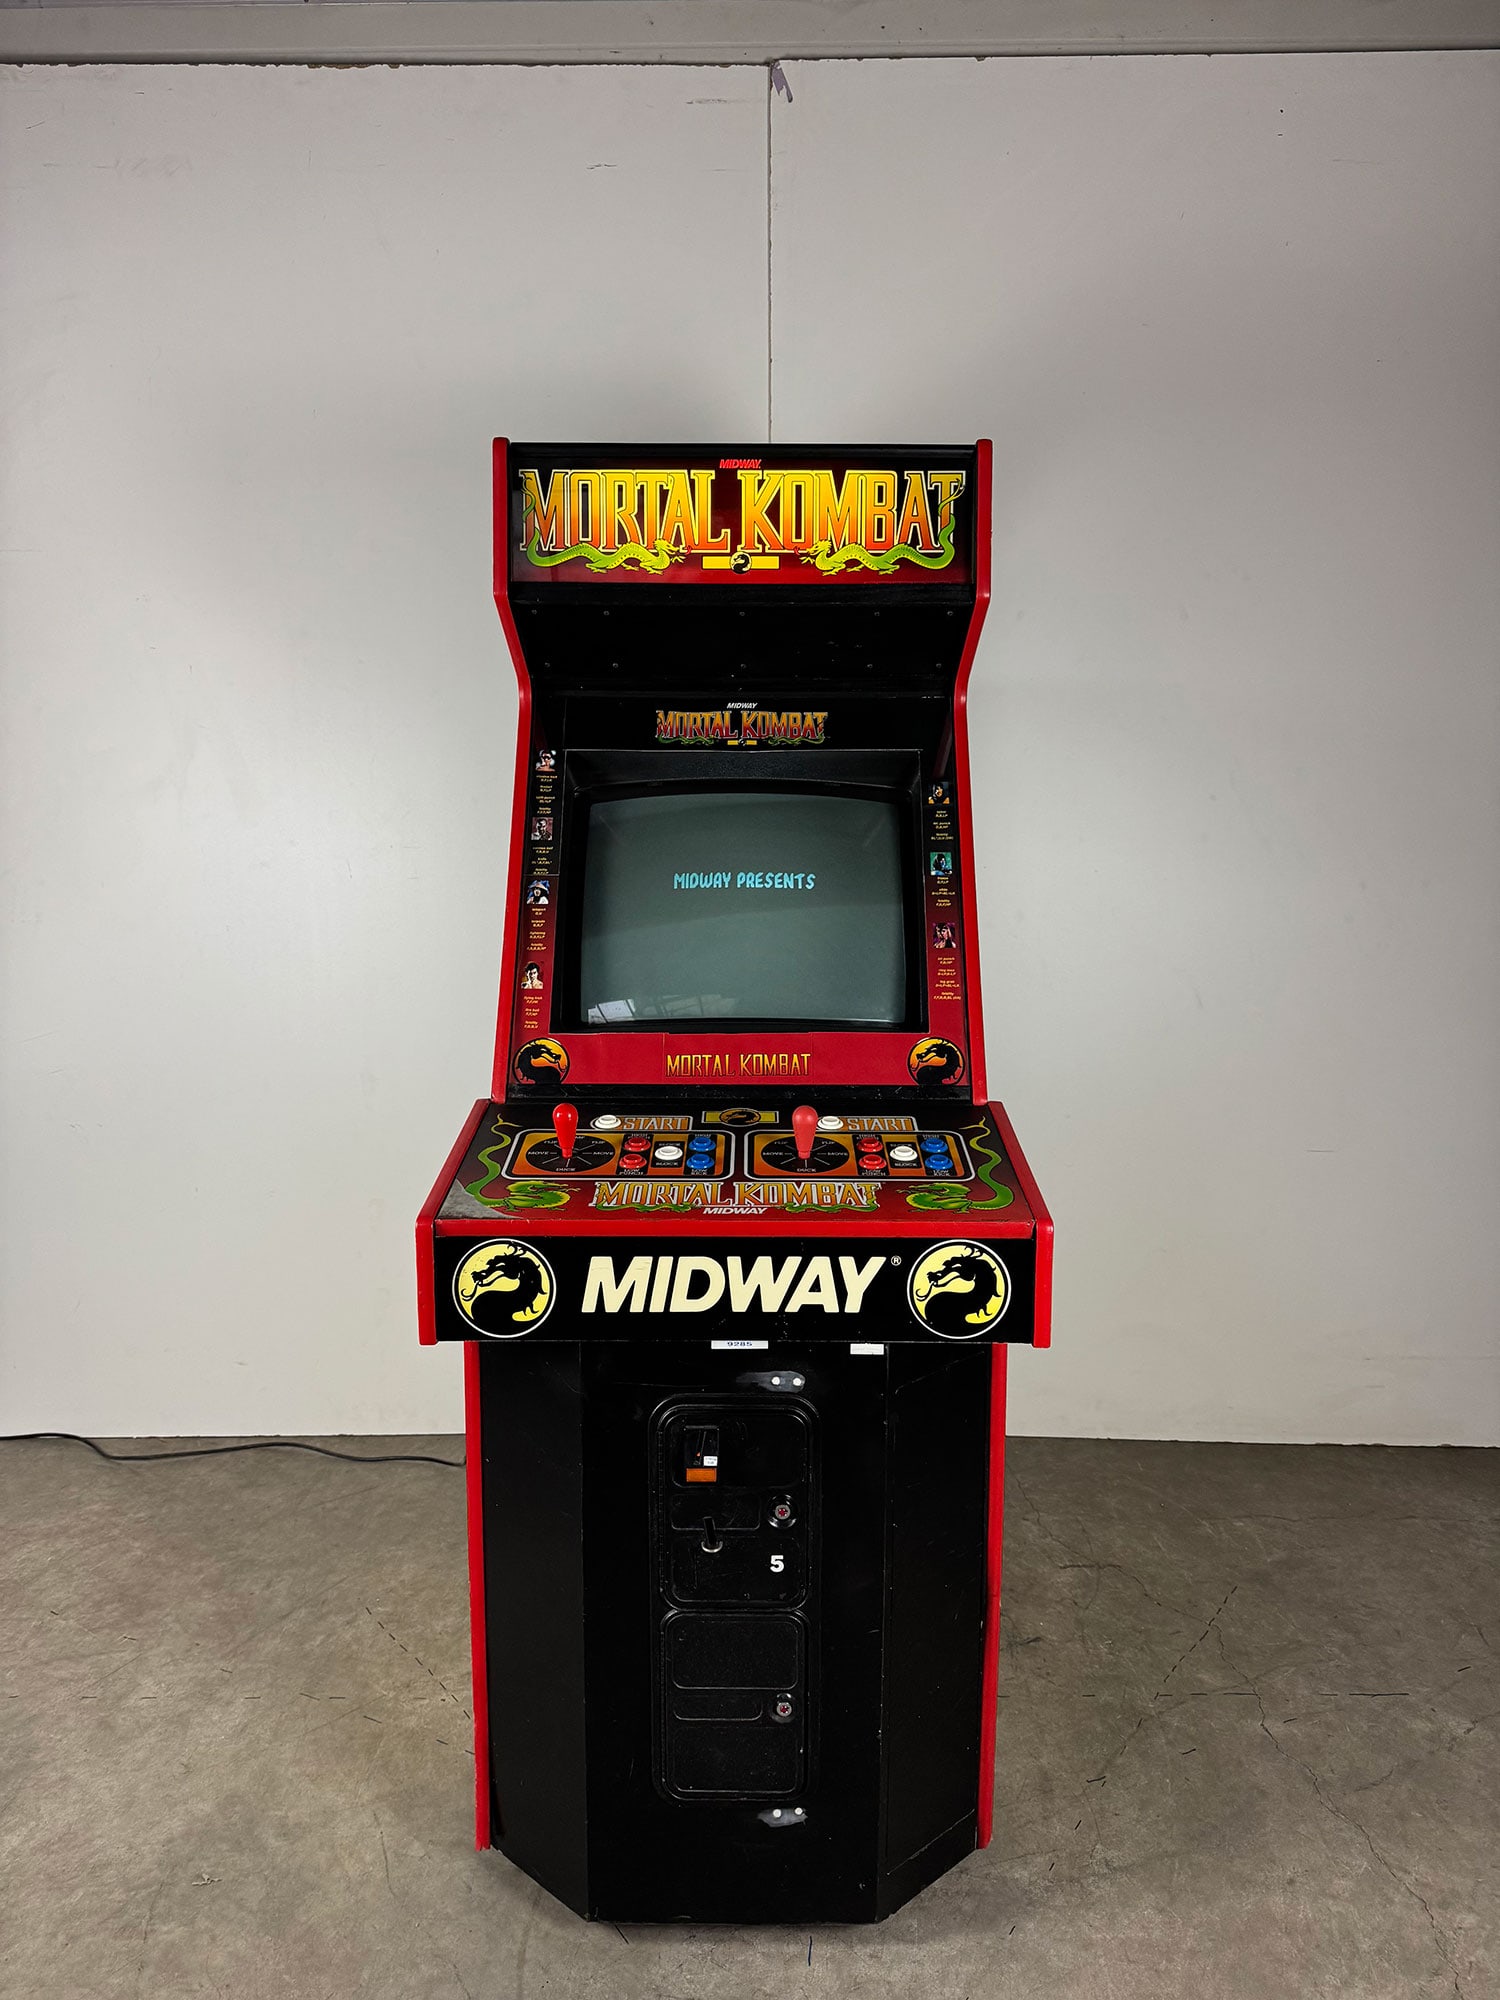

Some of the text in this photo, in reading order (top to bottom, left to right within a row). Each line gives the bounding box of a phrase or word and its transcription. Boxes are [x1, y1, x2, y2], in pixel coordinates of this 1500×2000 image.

[518, 468, 968, 554] MORTAL KOMBAT
[655, 709, 829, 739] MORTAL KOMBAT
[673, 872, 816, 890] MIDWAY PRESENTS
[665, 1052, 812, 1078] MORTAL KOMBAT
[623, 1117, 687, 1130] START
[847, 1117, 910, 1131] START
[588, 1181, 882, 1209] MORTAL KOMBAT
[702, 1207, 768, 1215] MIDWAY
[581, 1256, 887, 1313] MIDWAY
[769, 1554, 785, 1573] 5
